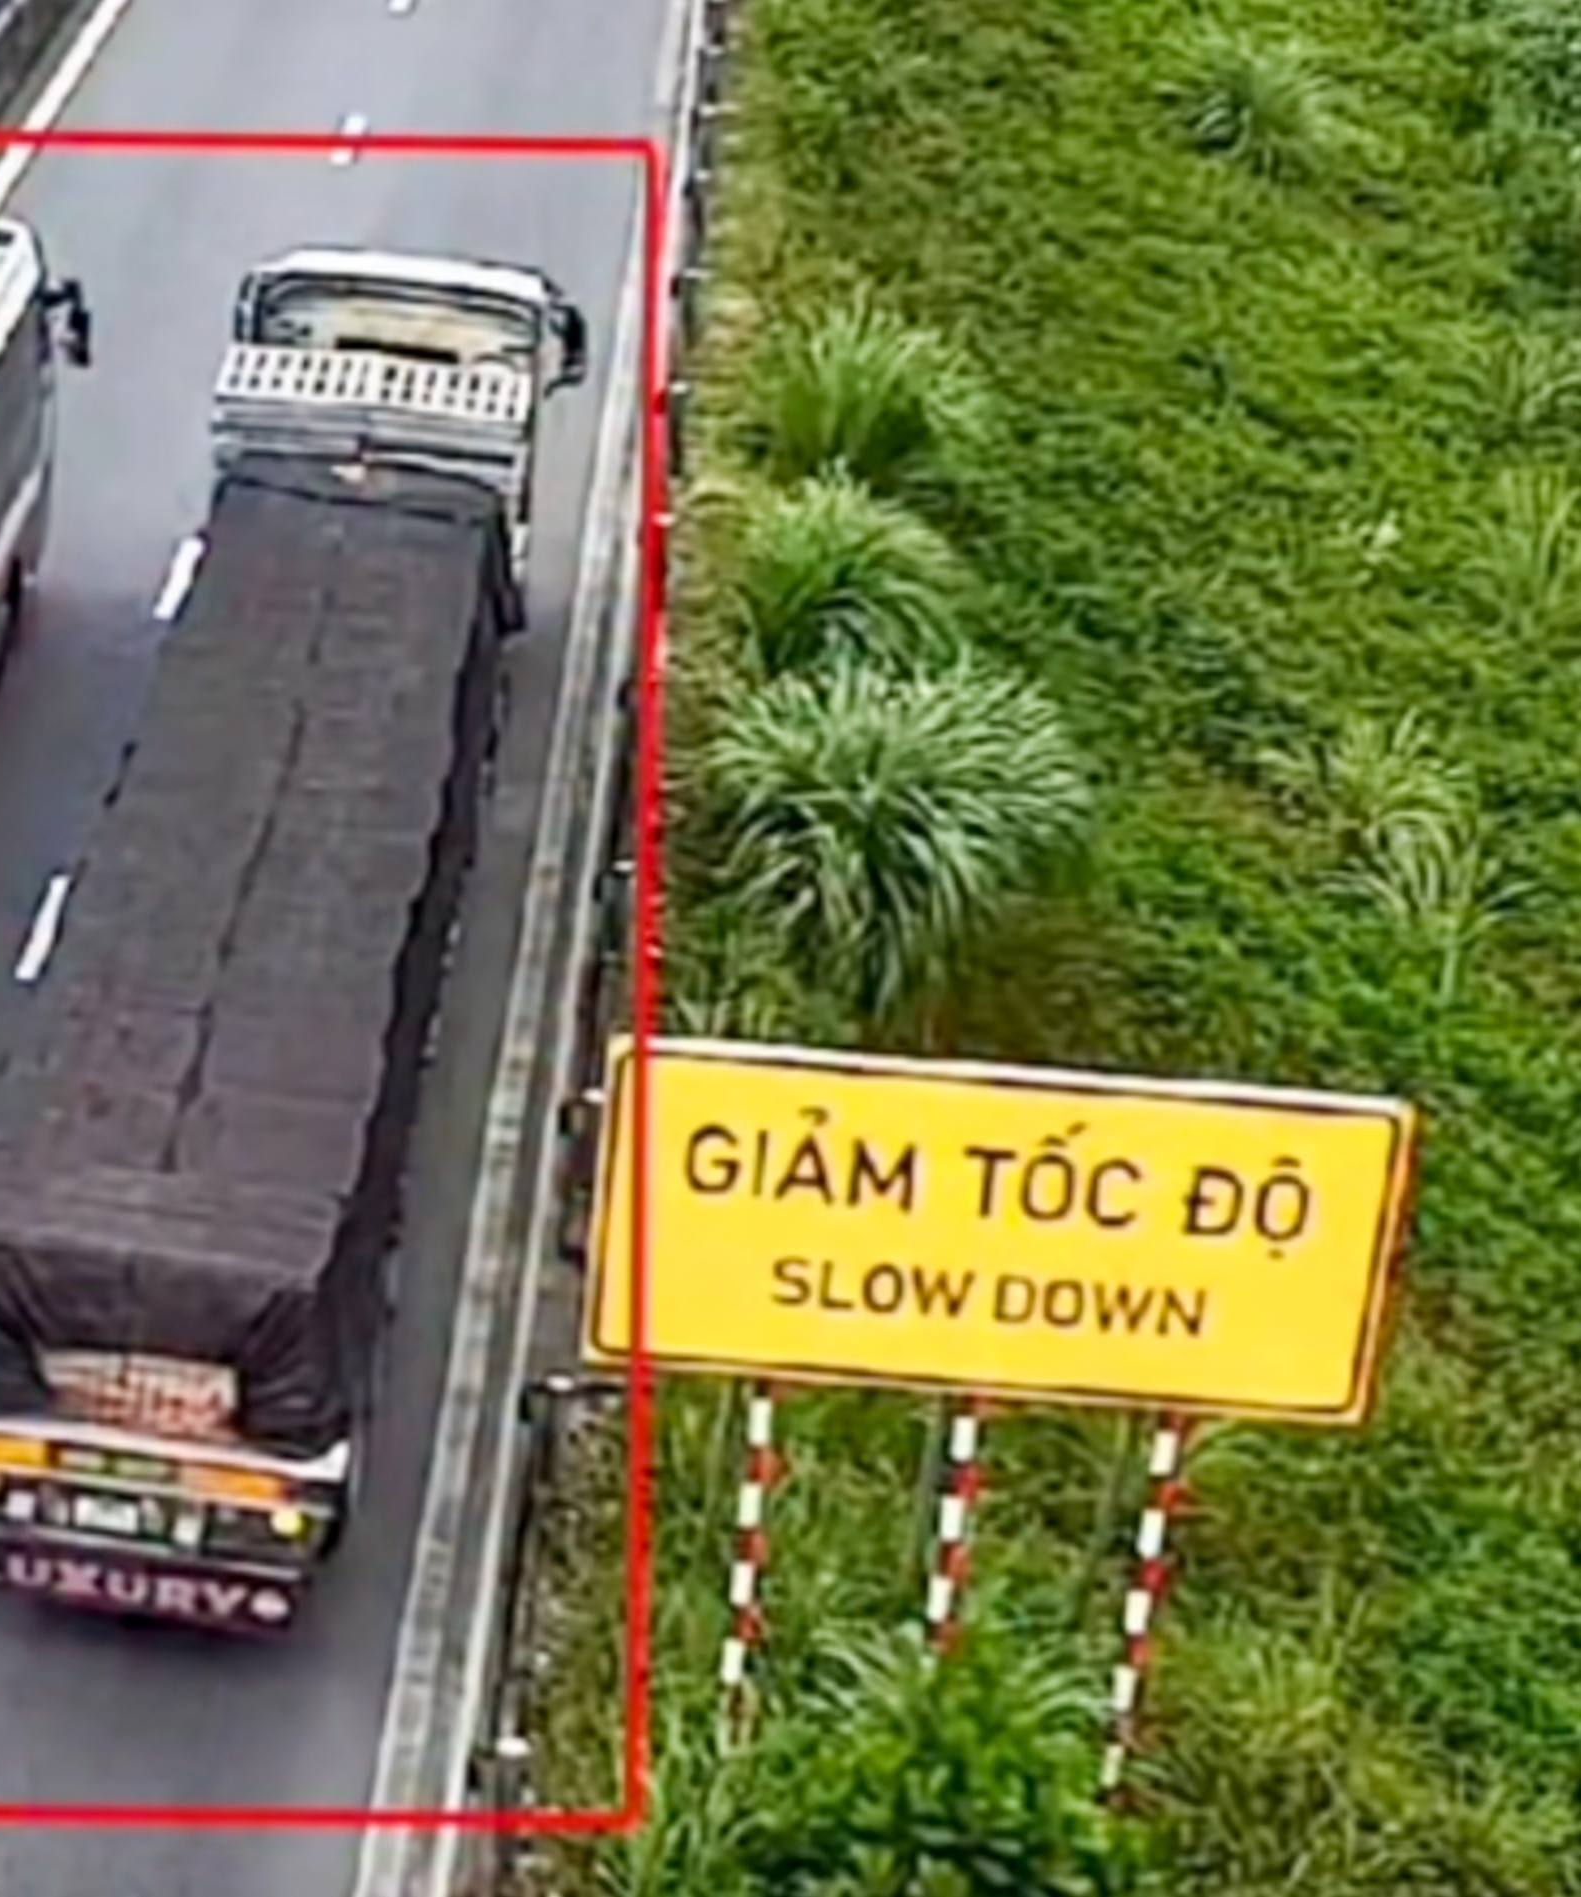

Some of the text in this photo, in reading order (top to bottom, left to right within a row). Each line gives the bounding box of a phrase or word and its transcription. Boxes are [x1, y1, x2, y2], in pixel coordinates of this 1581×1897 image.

[685, 1106, 1311, 1260] GIẢM TỐC ĐỘ
[771, 1256, 1207, 1337] SLOW DOWN
